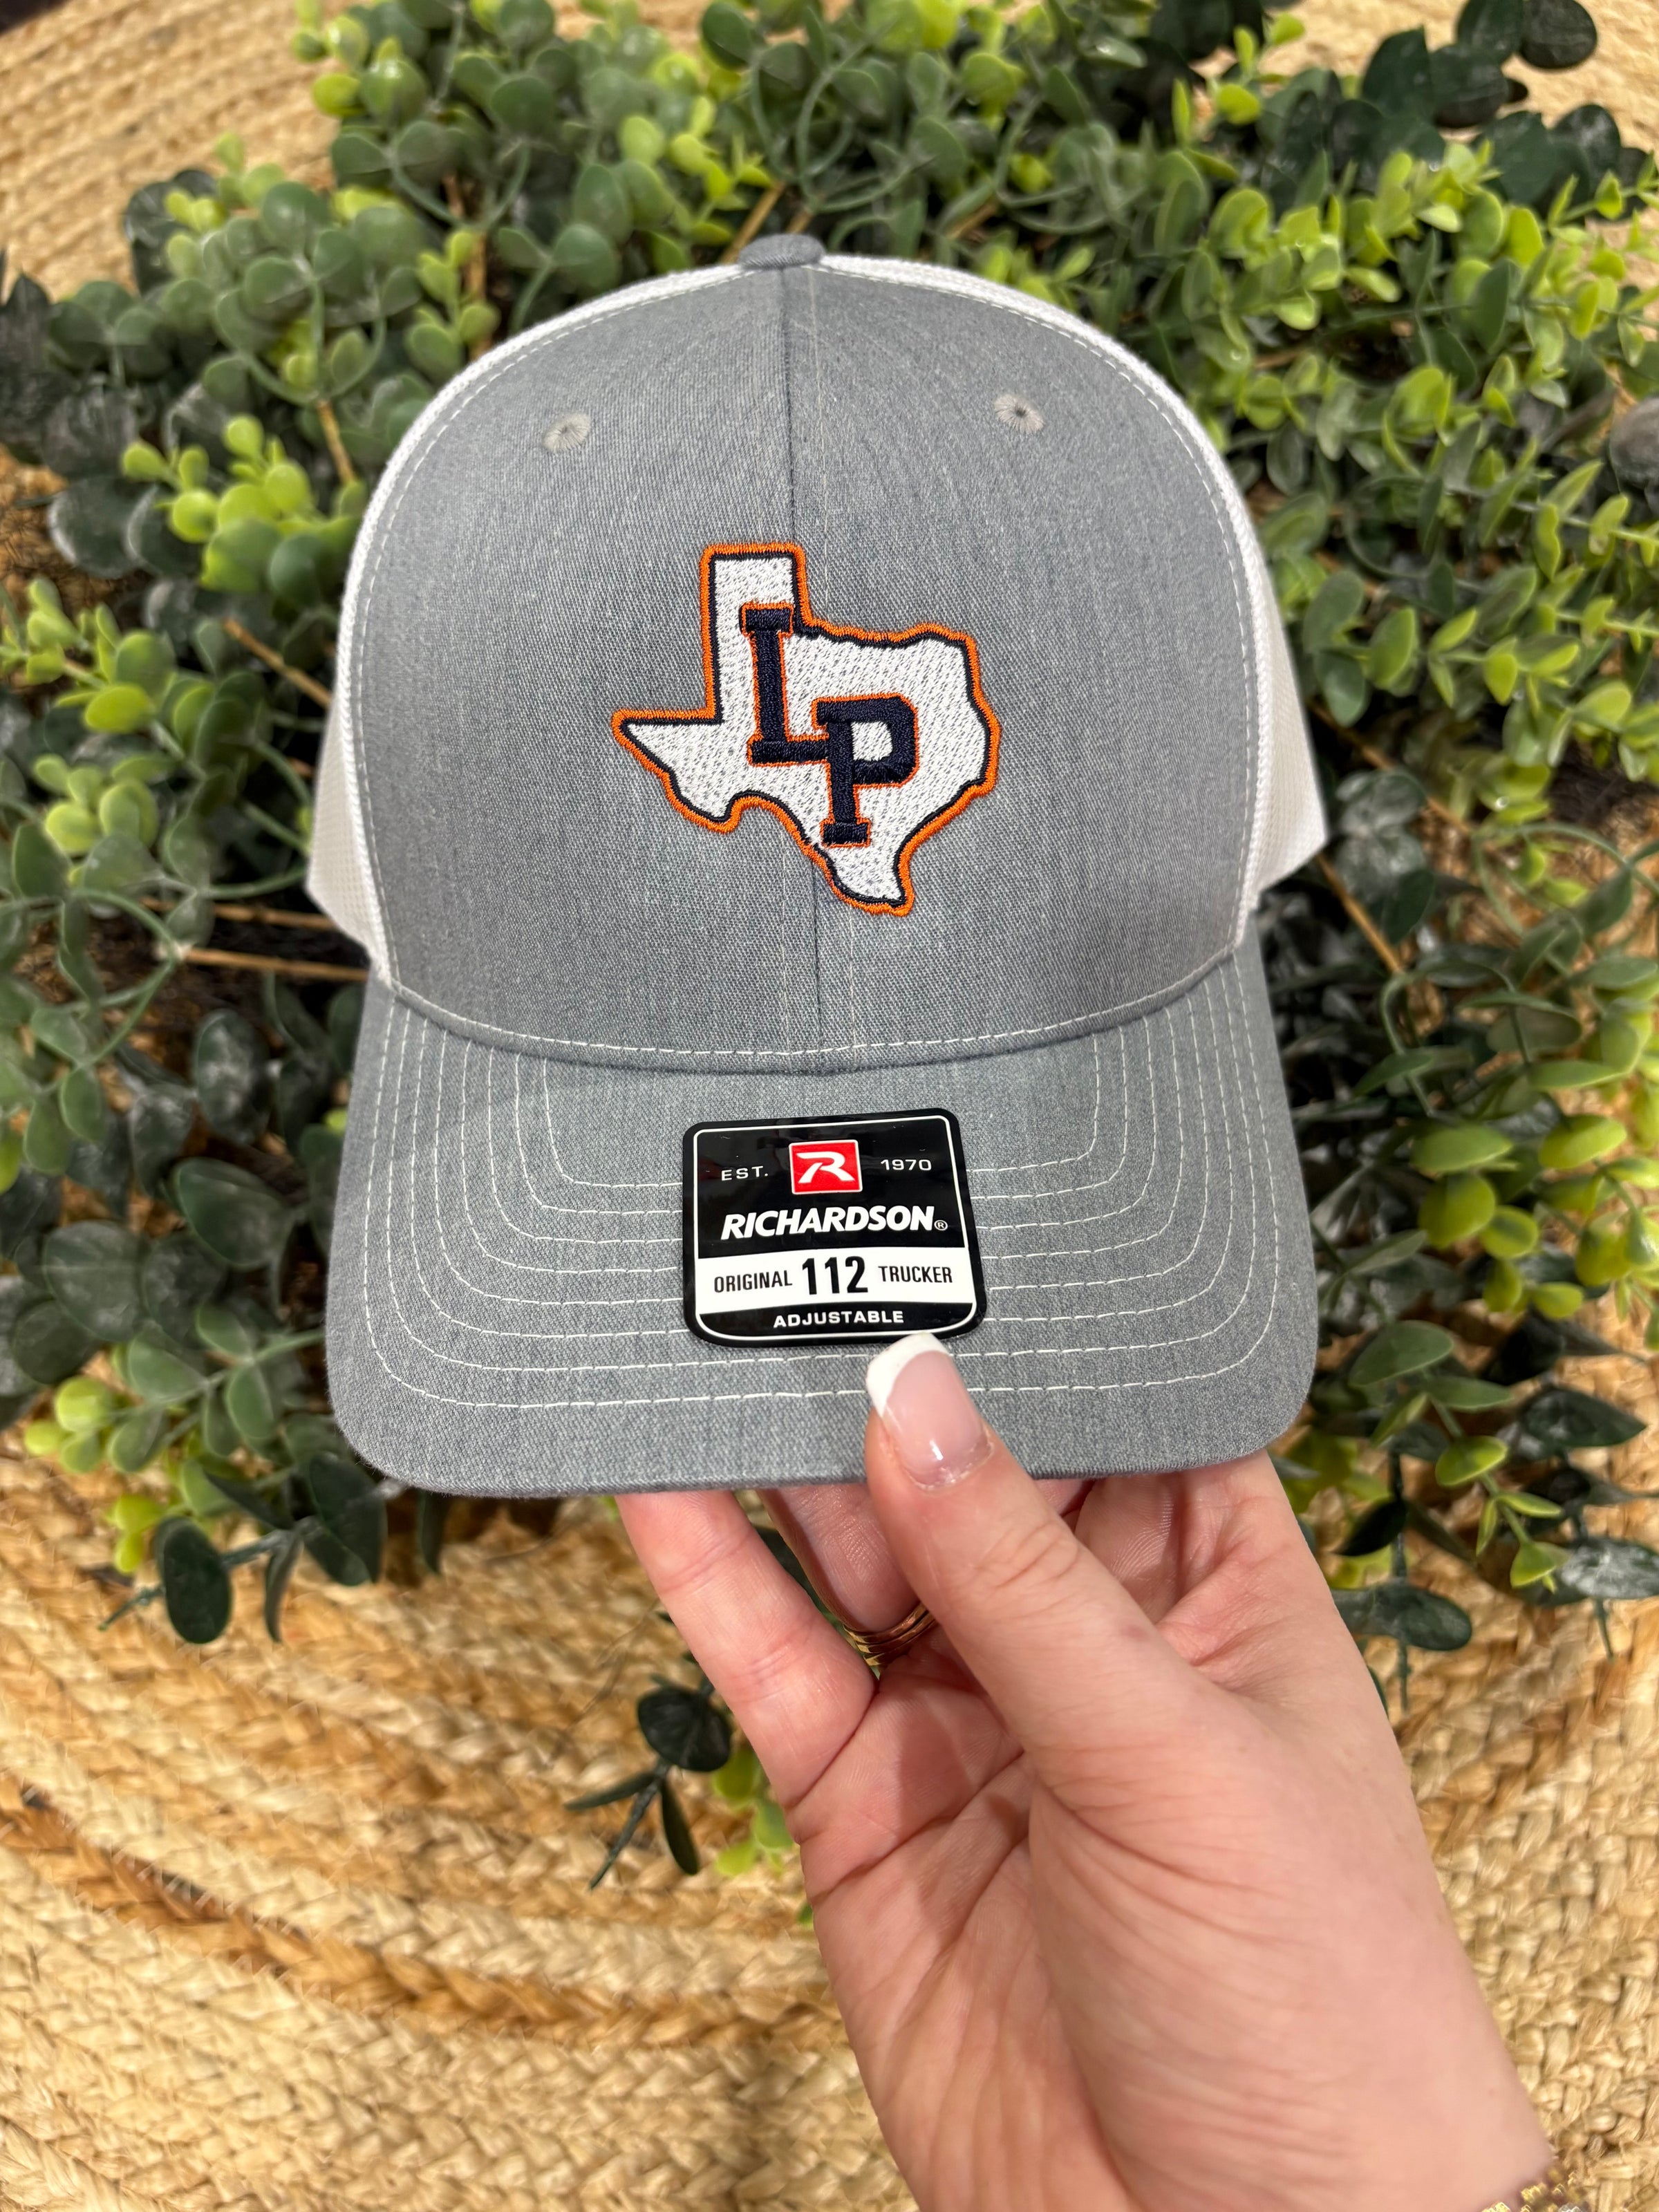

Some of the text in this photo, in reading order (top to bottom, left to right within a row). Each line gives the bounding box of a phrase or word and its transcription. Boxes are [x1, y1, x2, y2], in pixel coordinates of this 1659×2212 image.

[738, 601, 920, 847] LP
[721, 1159, 932, 1181] EST. 1970
[796, 1150, 856, 1184] R
[714, 1256, 953, 1295] ORIGINAL 112 TRUCKER
[773, 1311, 904, 1329] ADJUSTABLE
